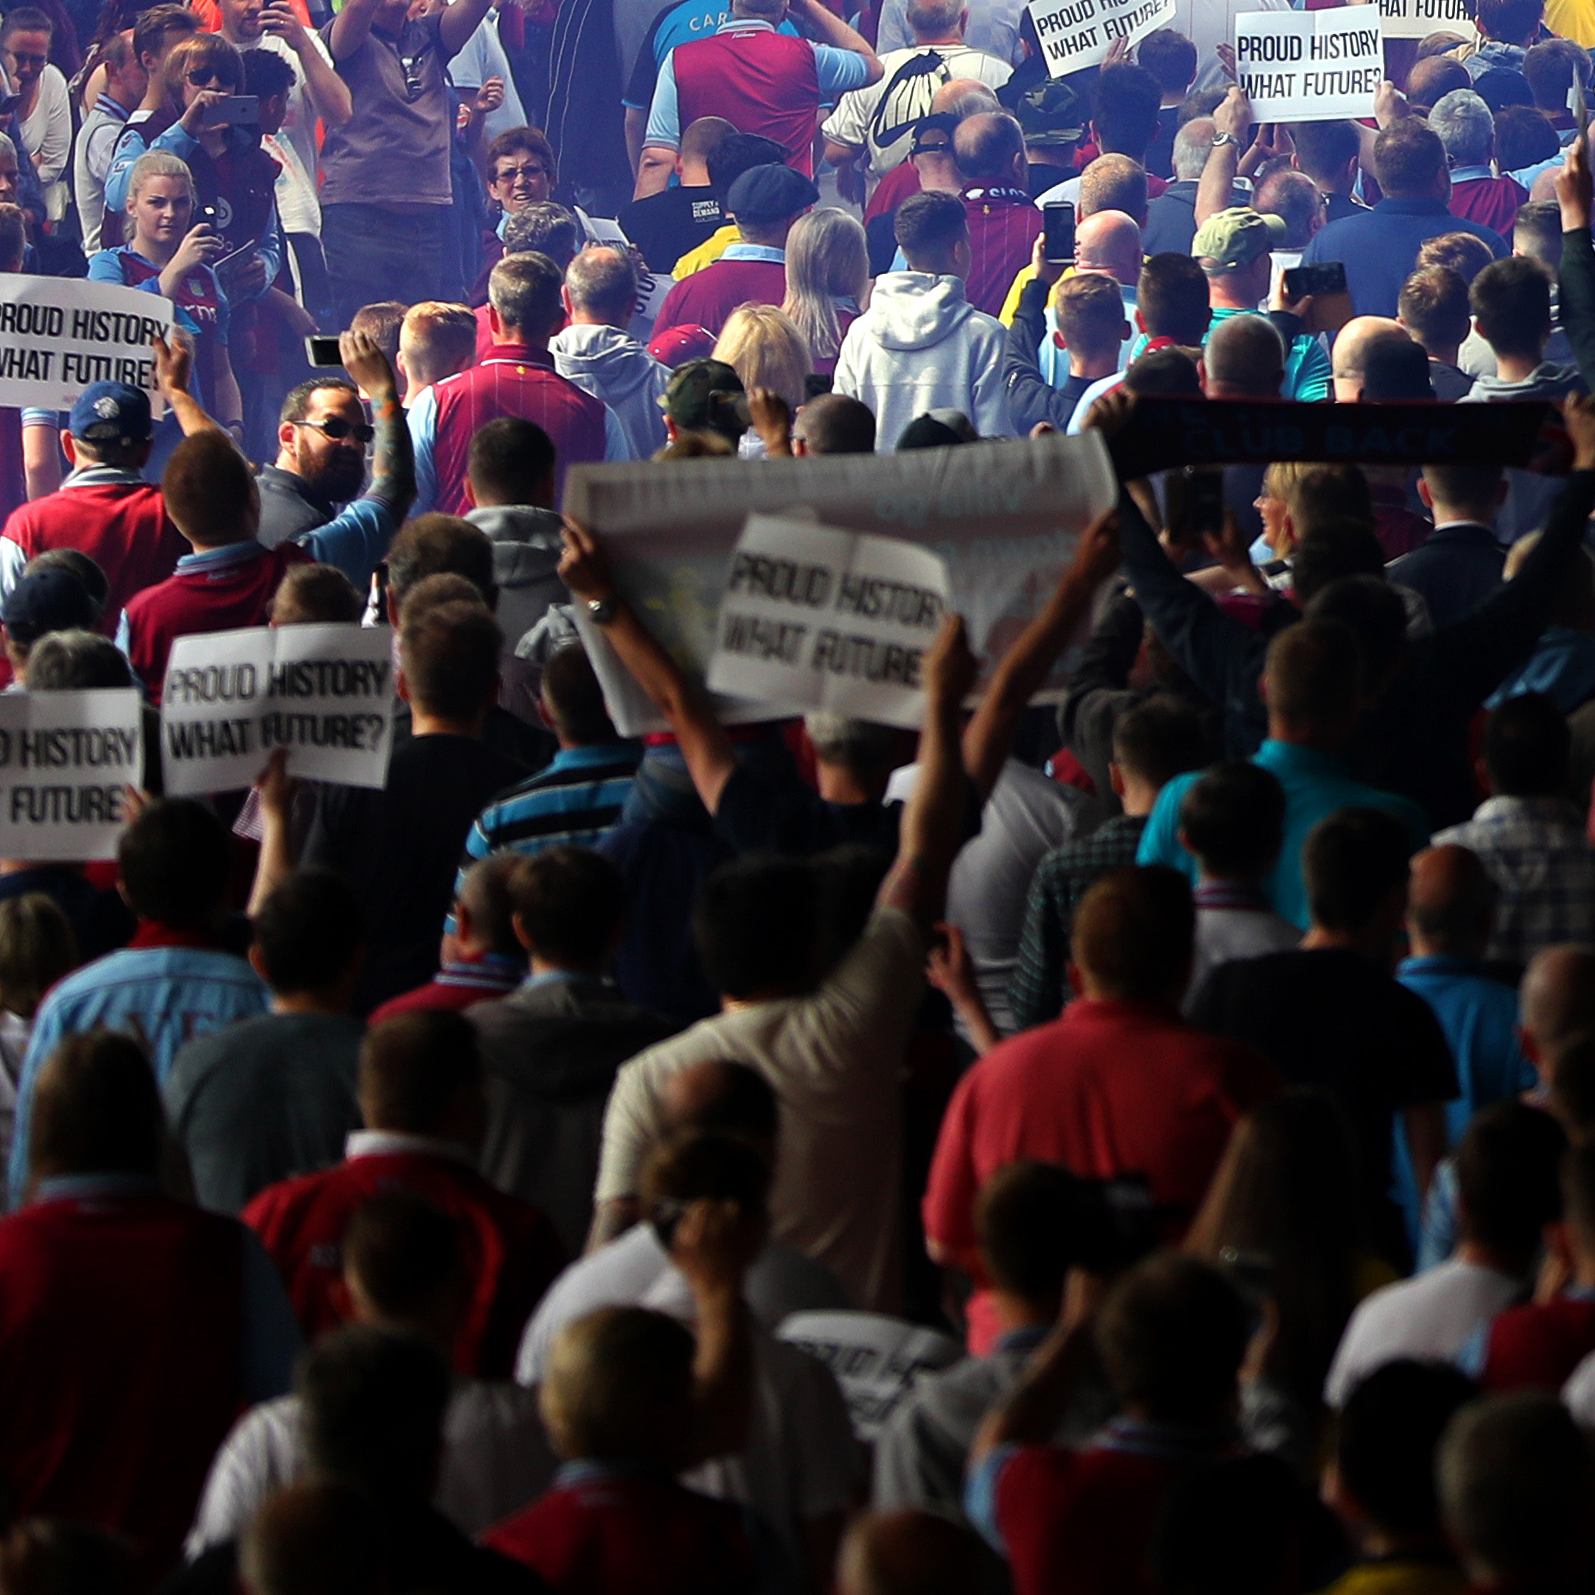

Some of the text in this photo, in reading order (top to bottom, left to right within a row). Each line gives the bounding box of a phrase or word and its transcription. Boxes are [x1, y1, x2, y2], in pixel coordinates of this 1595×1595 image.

[1037, 3, 1096, 37] PROUD
[1047, 26, 1101, 61] WHAT
[1237, 29, 1379, 62] PROUD HISTORY
[1240, 69, 1381, 98] WHAT FUTURE?
[0, 302, 64, 337] ROUD
[72, 308, 170, 347] HISTORY
[1325, 424, 1457, 457] BACK
[729, 549, 944, 630] PROUD HISTOR
[723, 612, 925, 687] WHAT FUTURE
[168, 659, 390, 704] PROUD HISTORY
[20, 726, 137, 768] HISTORY
[168, 711, 385, 761] WHAT FUTURE?
[10, 785, 124, 824] FUTURE
